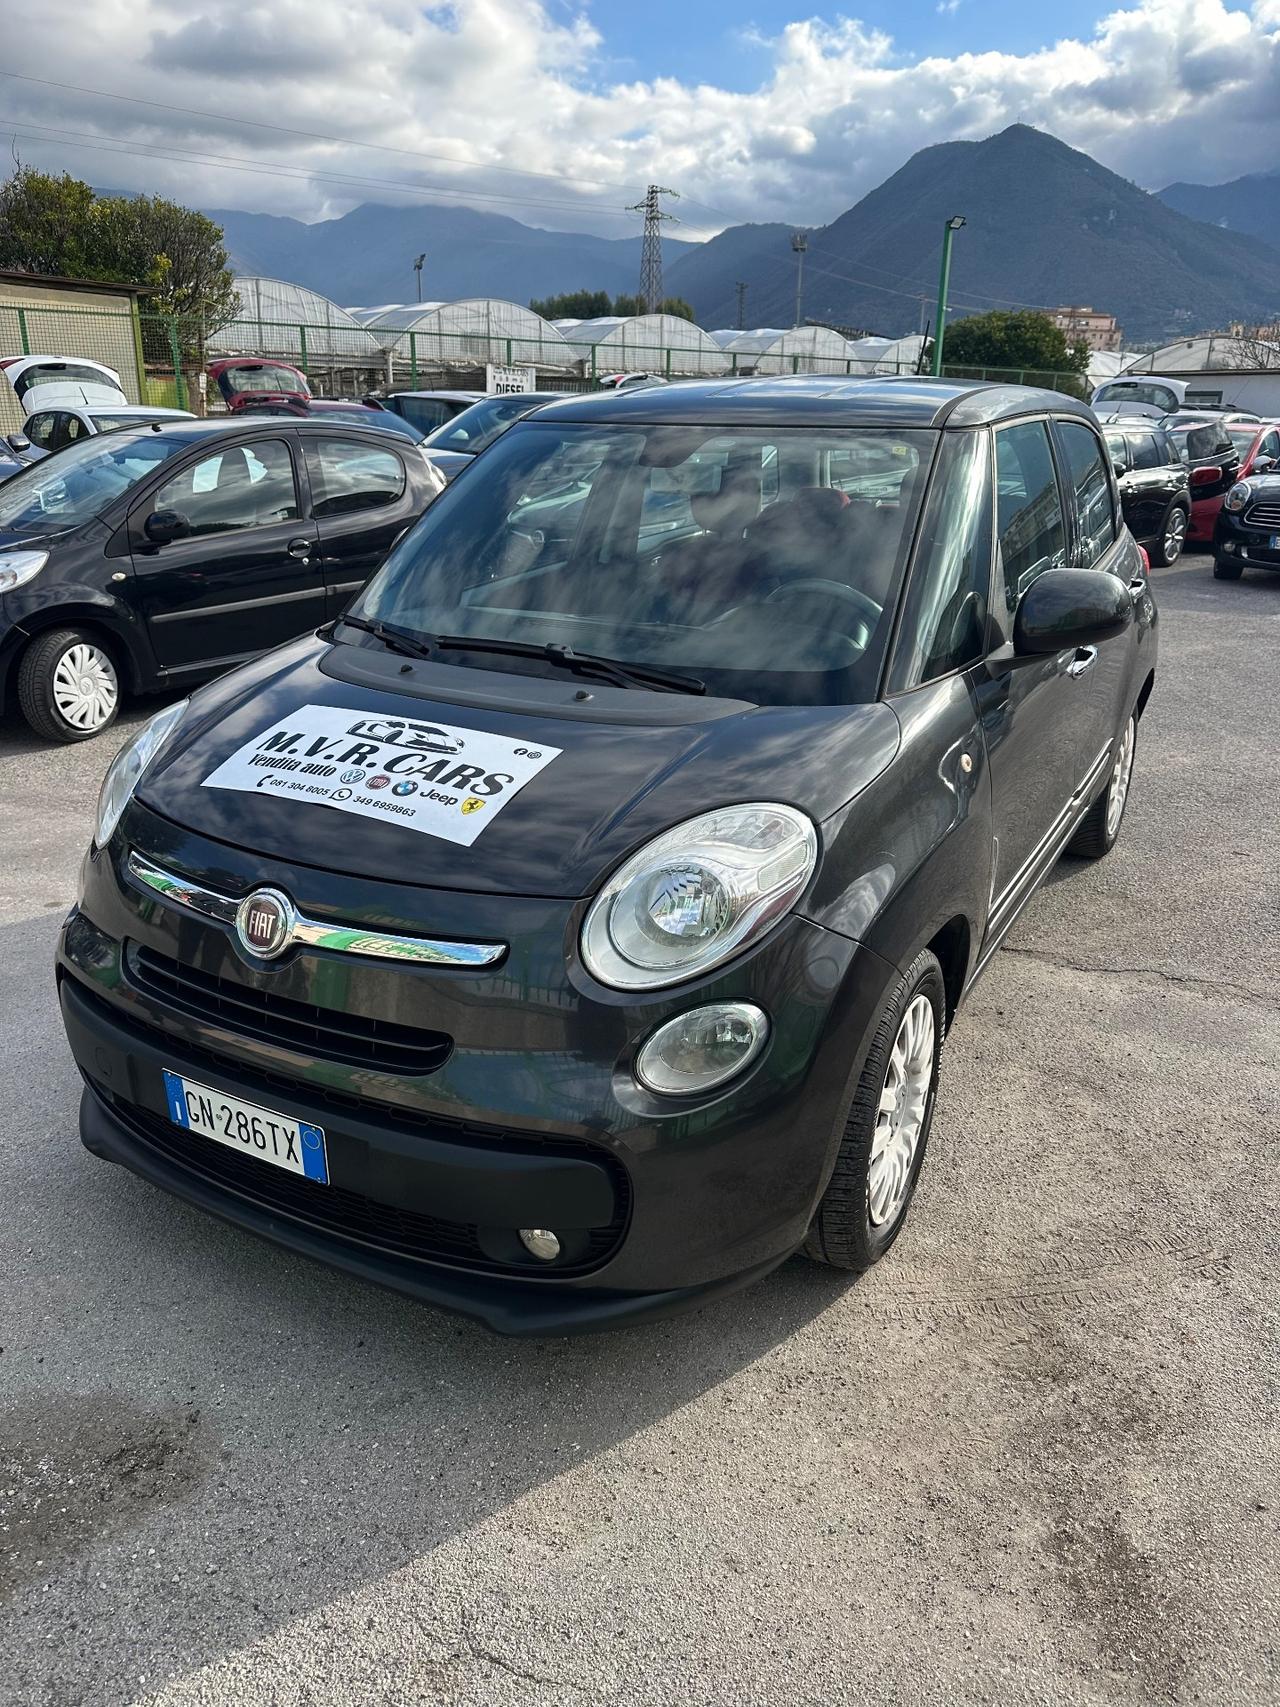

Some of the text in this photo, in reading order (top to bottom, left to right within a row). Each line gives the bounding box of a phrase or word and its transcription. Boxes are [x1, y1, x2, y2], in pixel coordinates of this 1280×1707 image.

[248, 754, 337, 777] Vendita auto
[270, 779, 331, 796] 081 304 8005
[419, 788, 459, 806] Jeep
[353, 795, 416, 817] 349 6959863
[248, 909, 276, 939] FIAT
